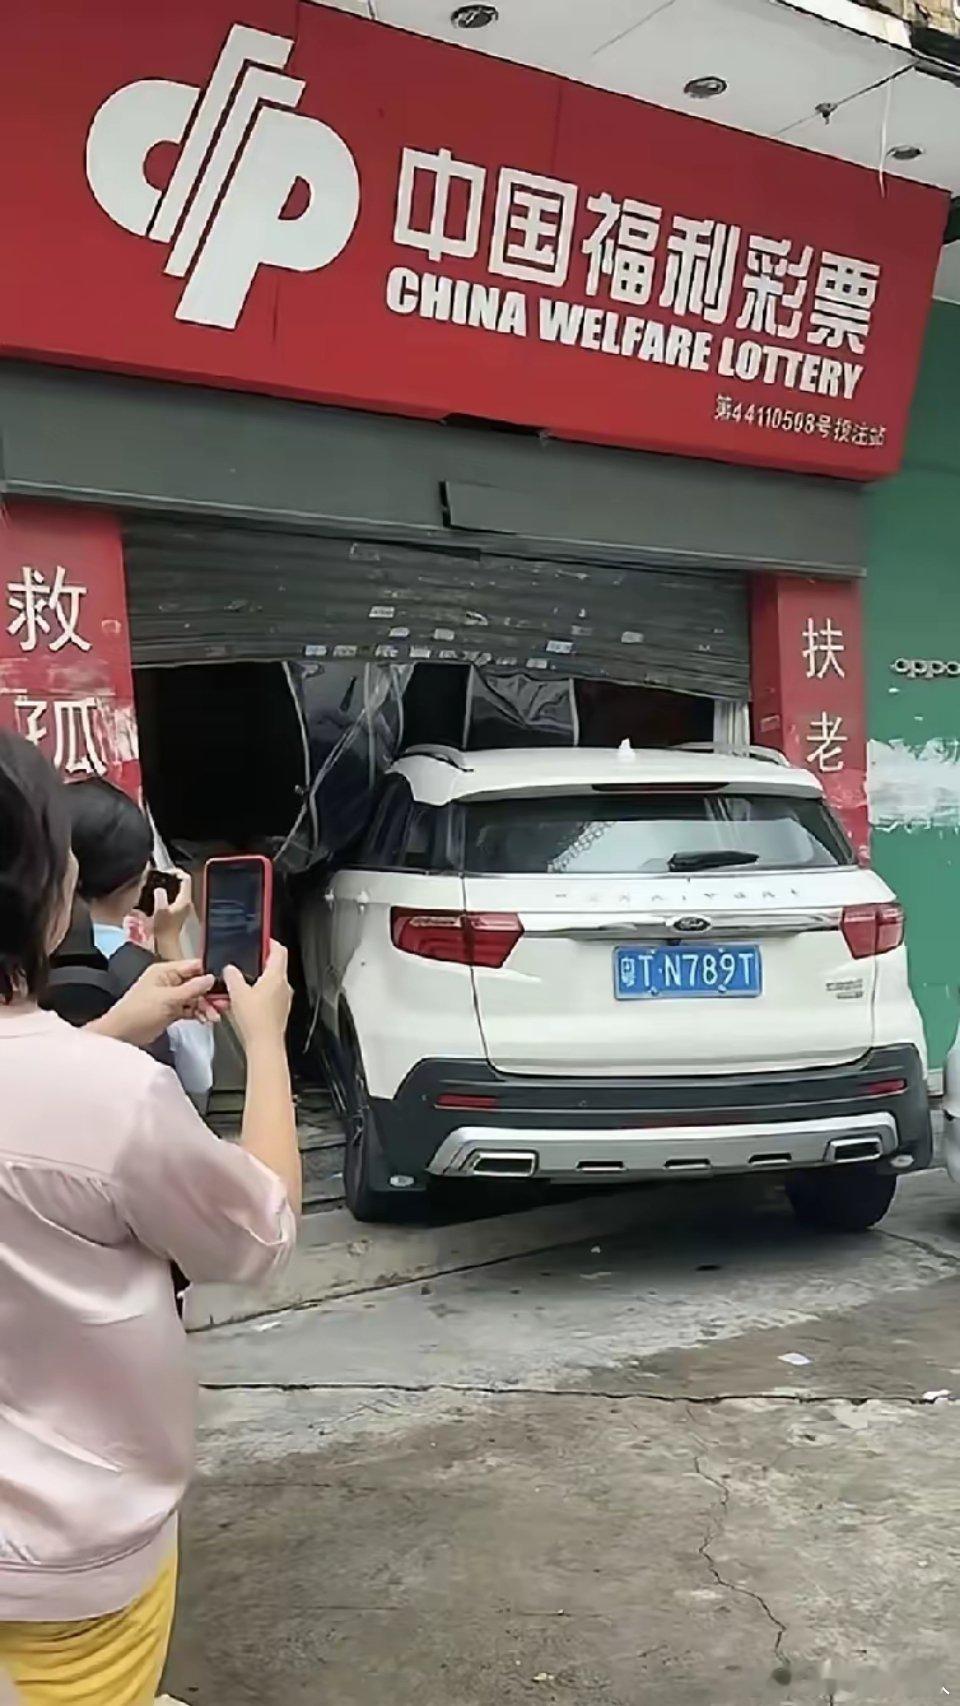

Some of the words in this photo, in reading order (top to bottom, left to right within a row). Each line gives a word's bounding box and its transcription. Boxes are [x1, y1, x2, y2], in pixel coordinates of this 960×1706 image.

[393, 147, 881, 354] 中国福利彩票
[386, 267, 527, 337] CHINA
[539, 298, 713, 372] WELFARE
[717, 337, 864, 400] LOTTERY
[802, 617, 848, 773] 扶老
